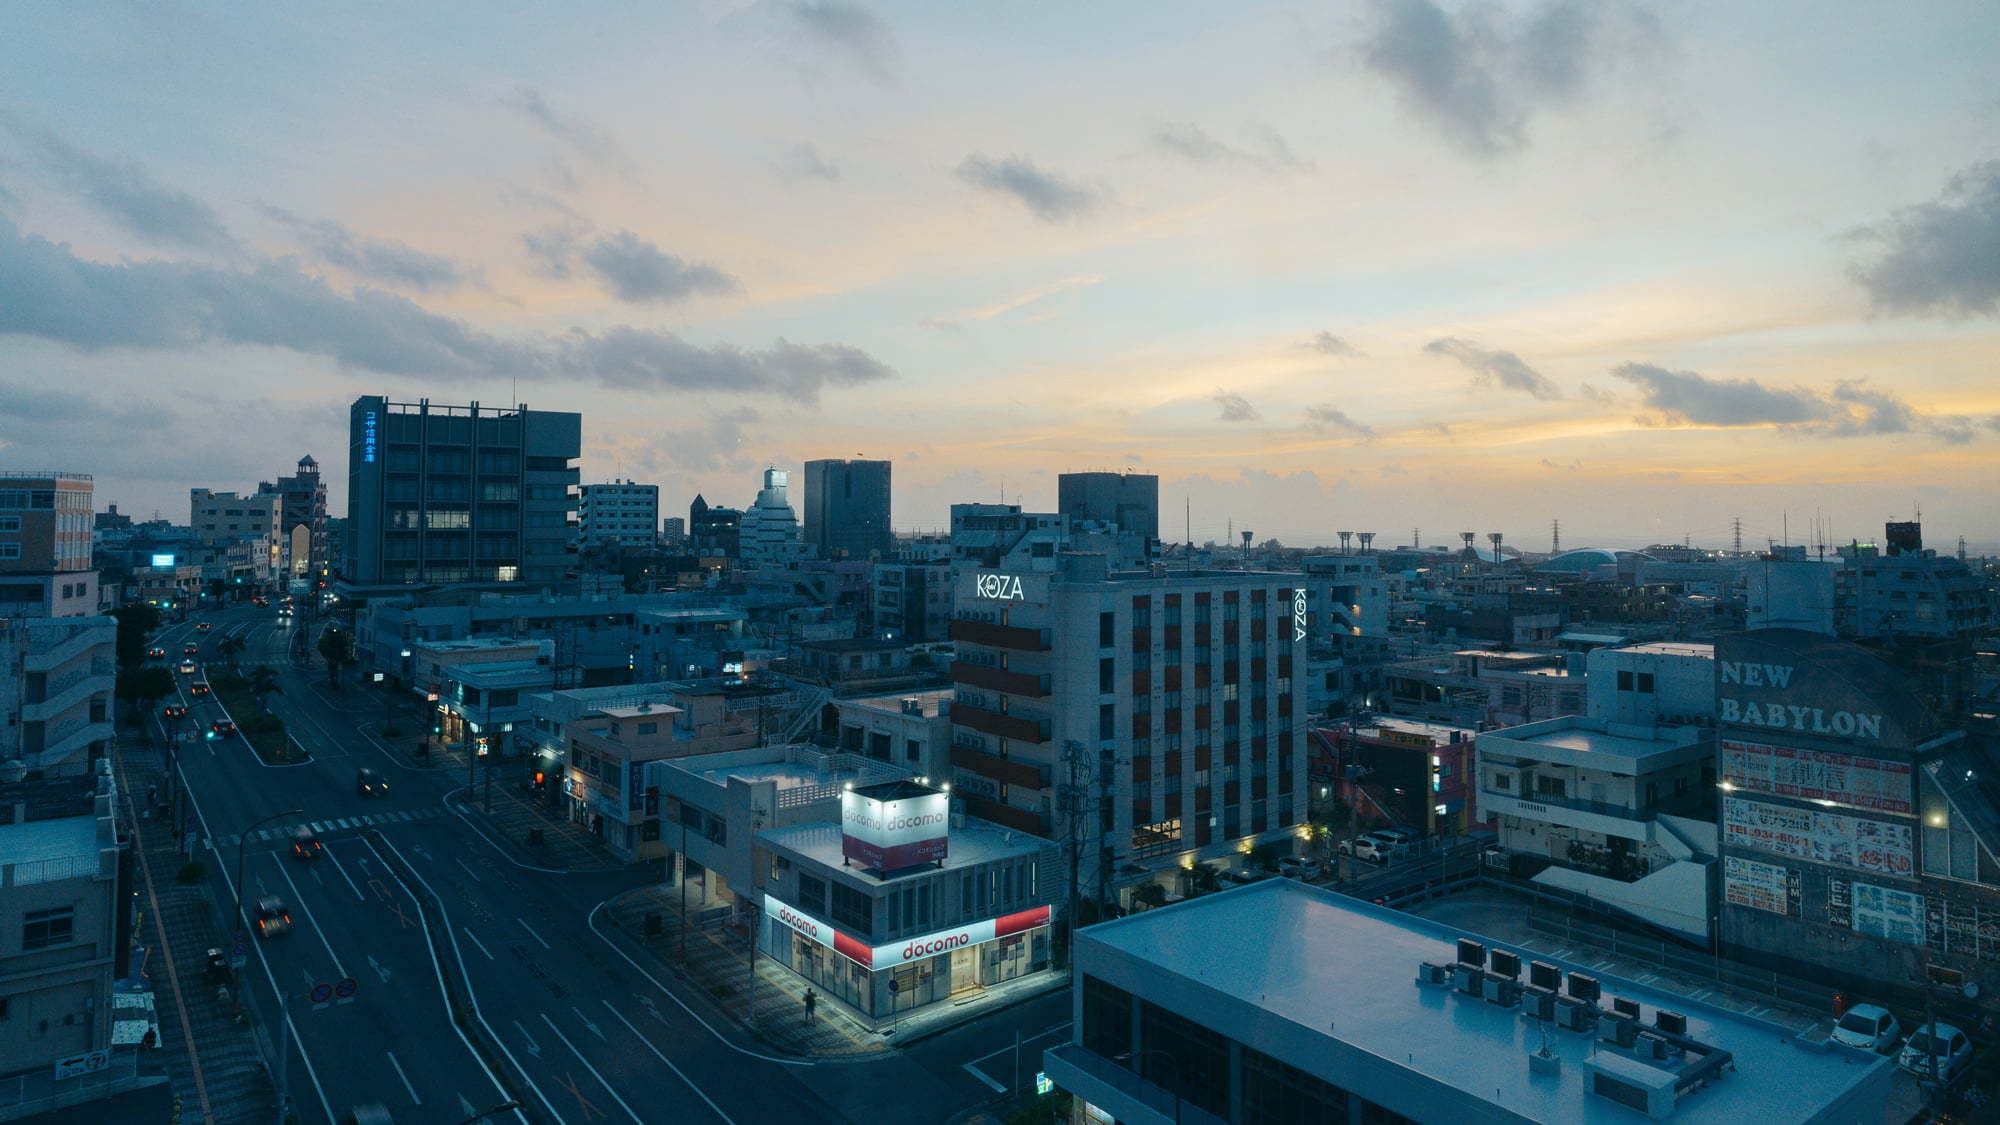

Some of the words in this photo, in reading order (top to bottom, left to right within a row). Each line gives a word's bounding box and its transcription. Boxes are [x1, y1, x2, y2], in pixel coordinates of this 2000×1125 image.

[977, 574, 1024, 601] KOZA
[1295, 588, 1306, 642] KOZA
[1721, 661, 1794, 688] NEW
[1721, 698, 1882, 739] BABYLON
[844, 808, 881, 831] docomo
[887, 812, 944, 831] docomo
[779, 906, 818, 938] docomo
[902, 932, 969, 960] docomo
